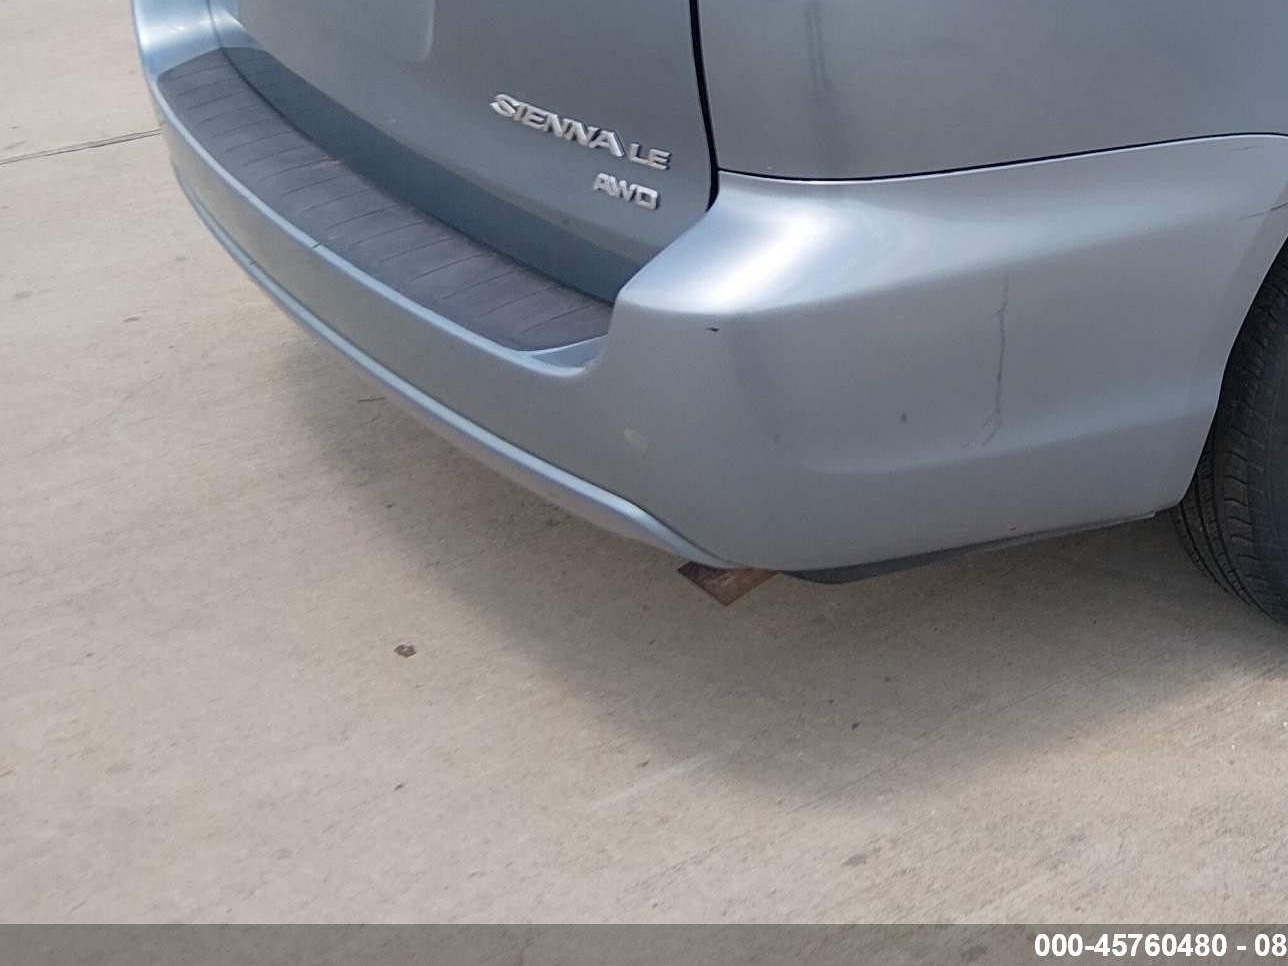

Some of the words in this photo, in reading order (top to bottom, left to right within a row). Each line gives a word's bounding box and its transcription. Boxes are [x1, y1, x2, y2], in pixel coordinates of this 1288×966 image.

[489, 93, 625, 158] SIENNA
[627, 142, 672, 171] LE
[592, 172, 661, 211] AWD
